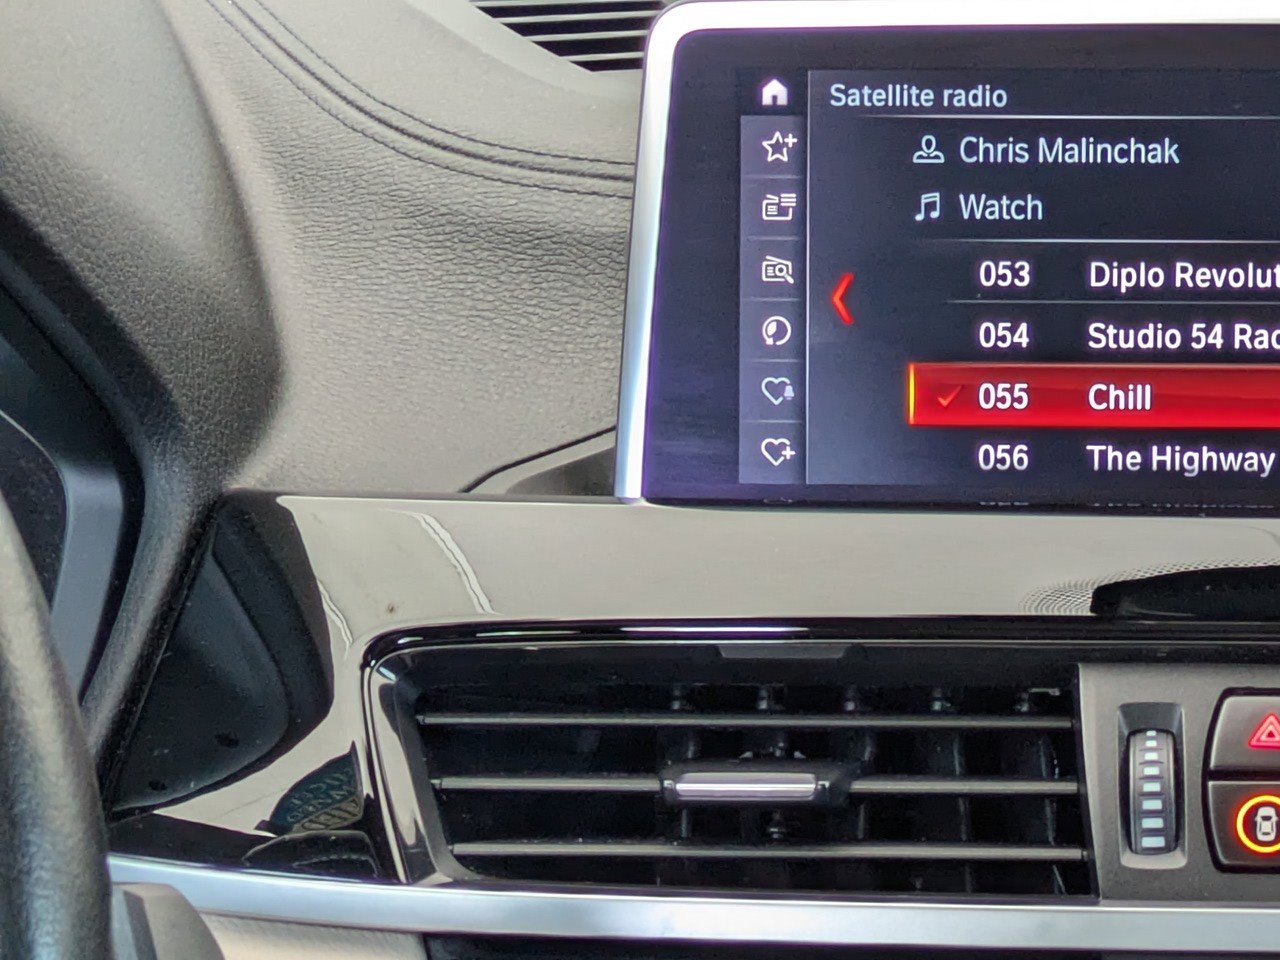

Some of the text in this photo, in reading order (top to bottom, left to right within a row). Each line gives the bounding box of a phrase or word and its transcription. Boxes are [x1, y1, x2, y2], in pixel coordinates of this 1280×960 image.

[831, 84, 1007, 107] Satellite radio
[960, 137, 1179, 163] Chris Malinchak
[959, 194, 1042, 220] Watch
[980, 261, 1030, 287] 053
[1091, 262, 1164, 294] Diplo
[980, 322, 1029, 348] 054
[1089, 323, 1181, 350] Studio
[1191, 323, 1223, 349] 54
[979, 383, 1151, 410] 055 Chill
[979, 444, 1275, 478] 056 The Highway
